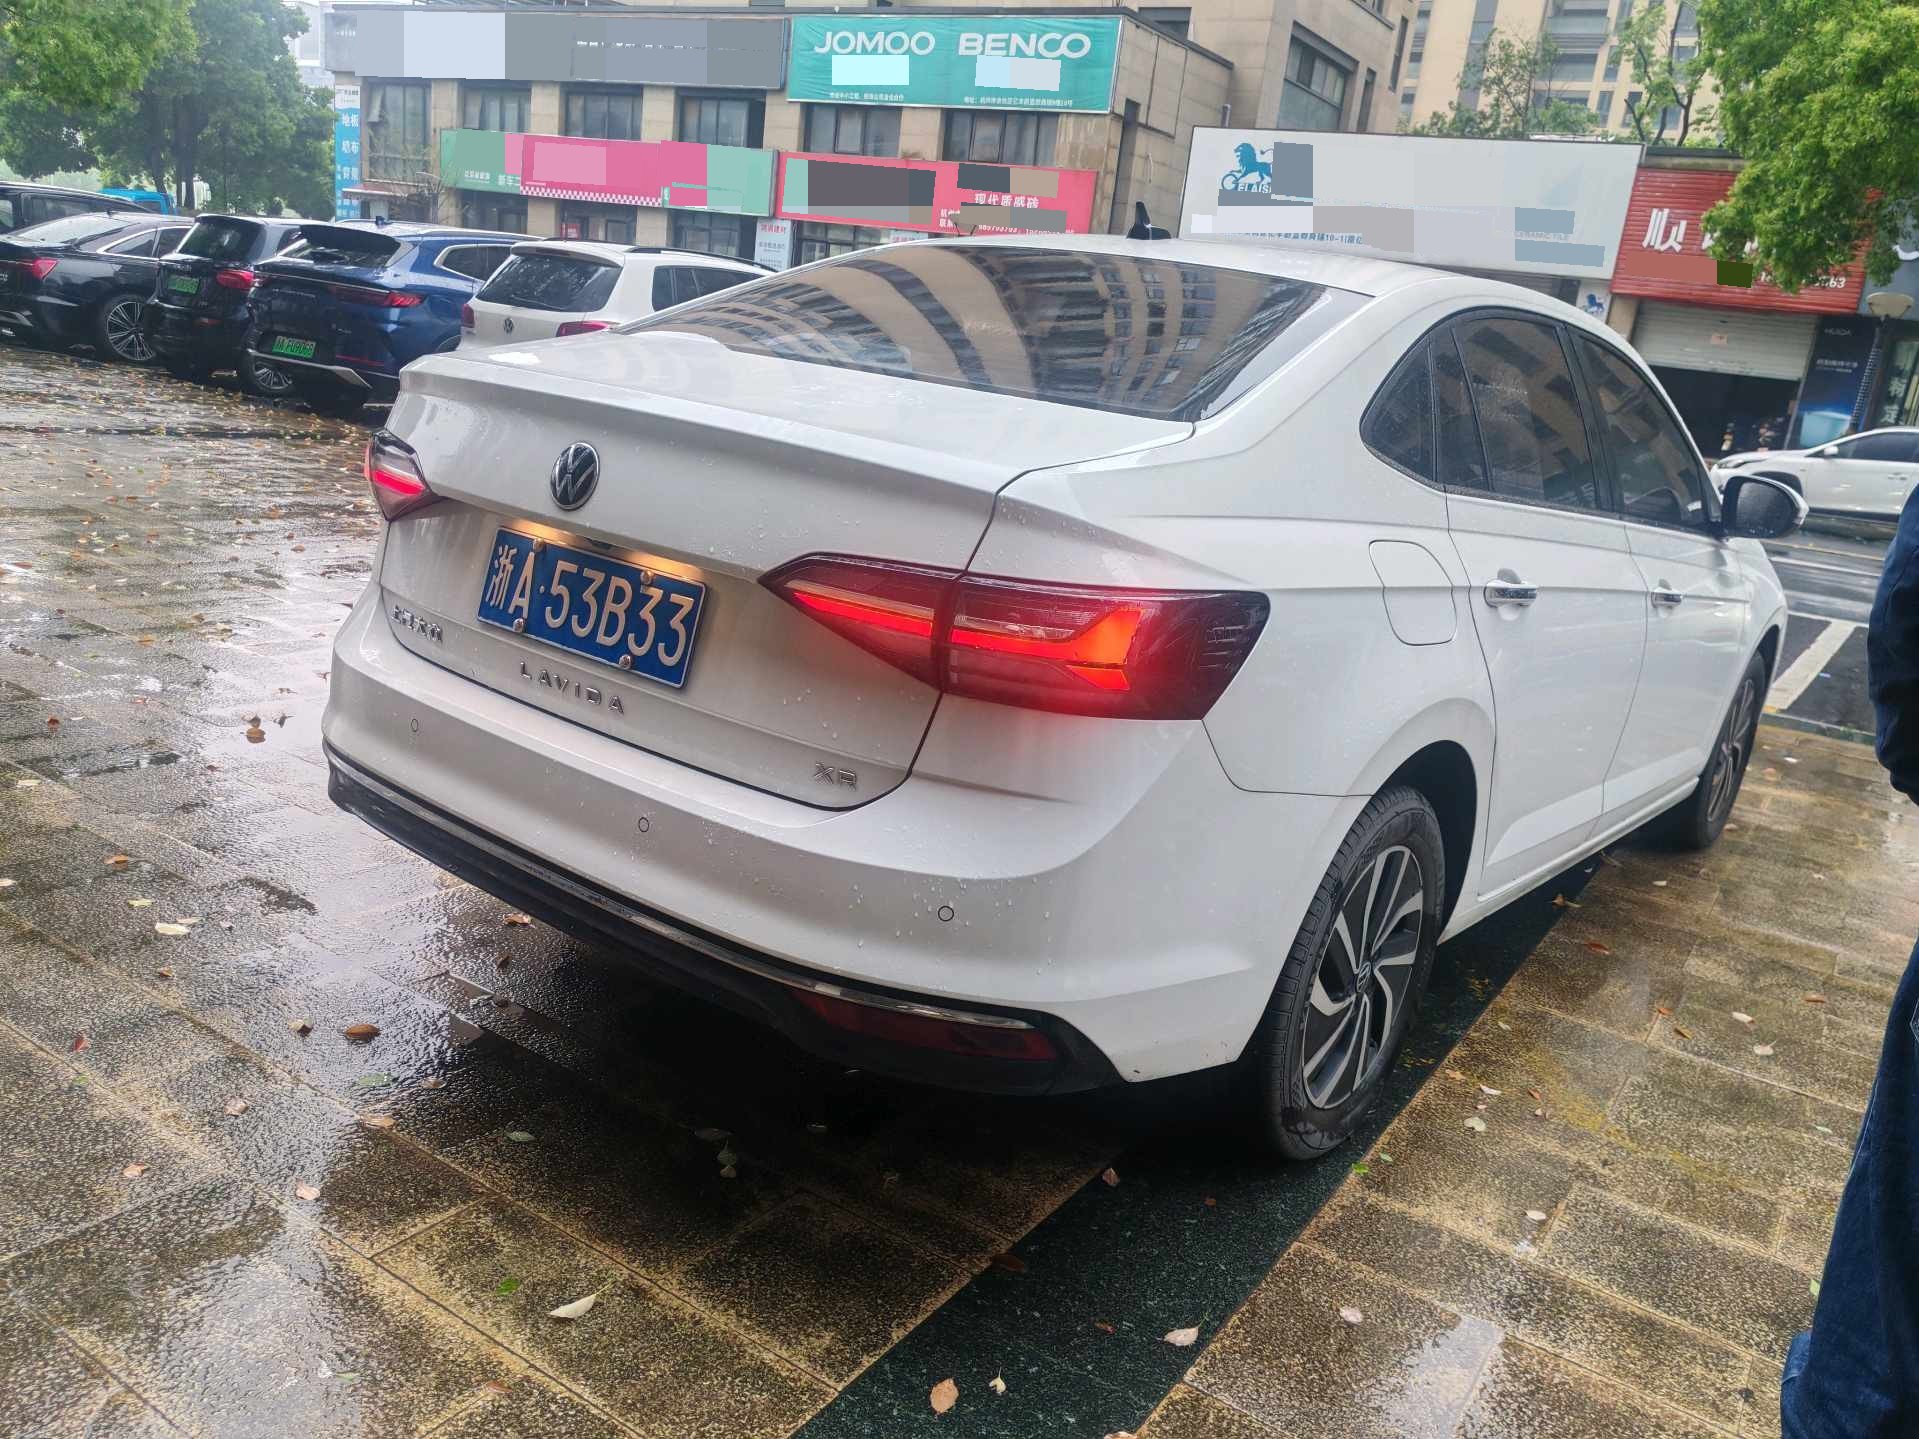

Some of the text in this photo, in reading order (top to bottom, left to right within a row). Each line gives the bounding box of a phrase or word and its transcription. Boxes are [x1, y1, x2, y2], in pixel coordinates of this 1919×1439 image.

[814, 31, 1092, 59] JOMOO BENCO
[520, 662, 624, 715] LAVIDA
[814, 762, 857, 792] XR
